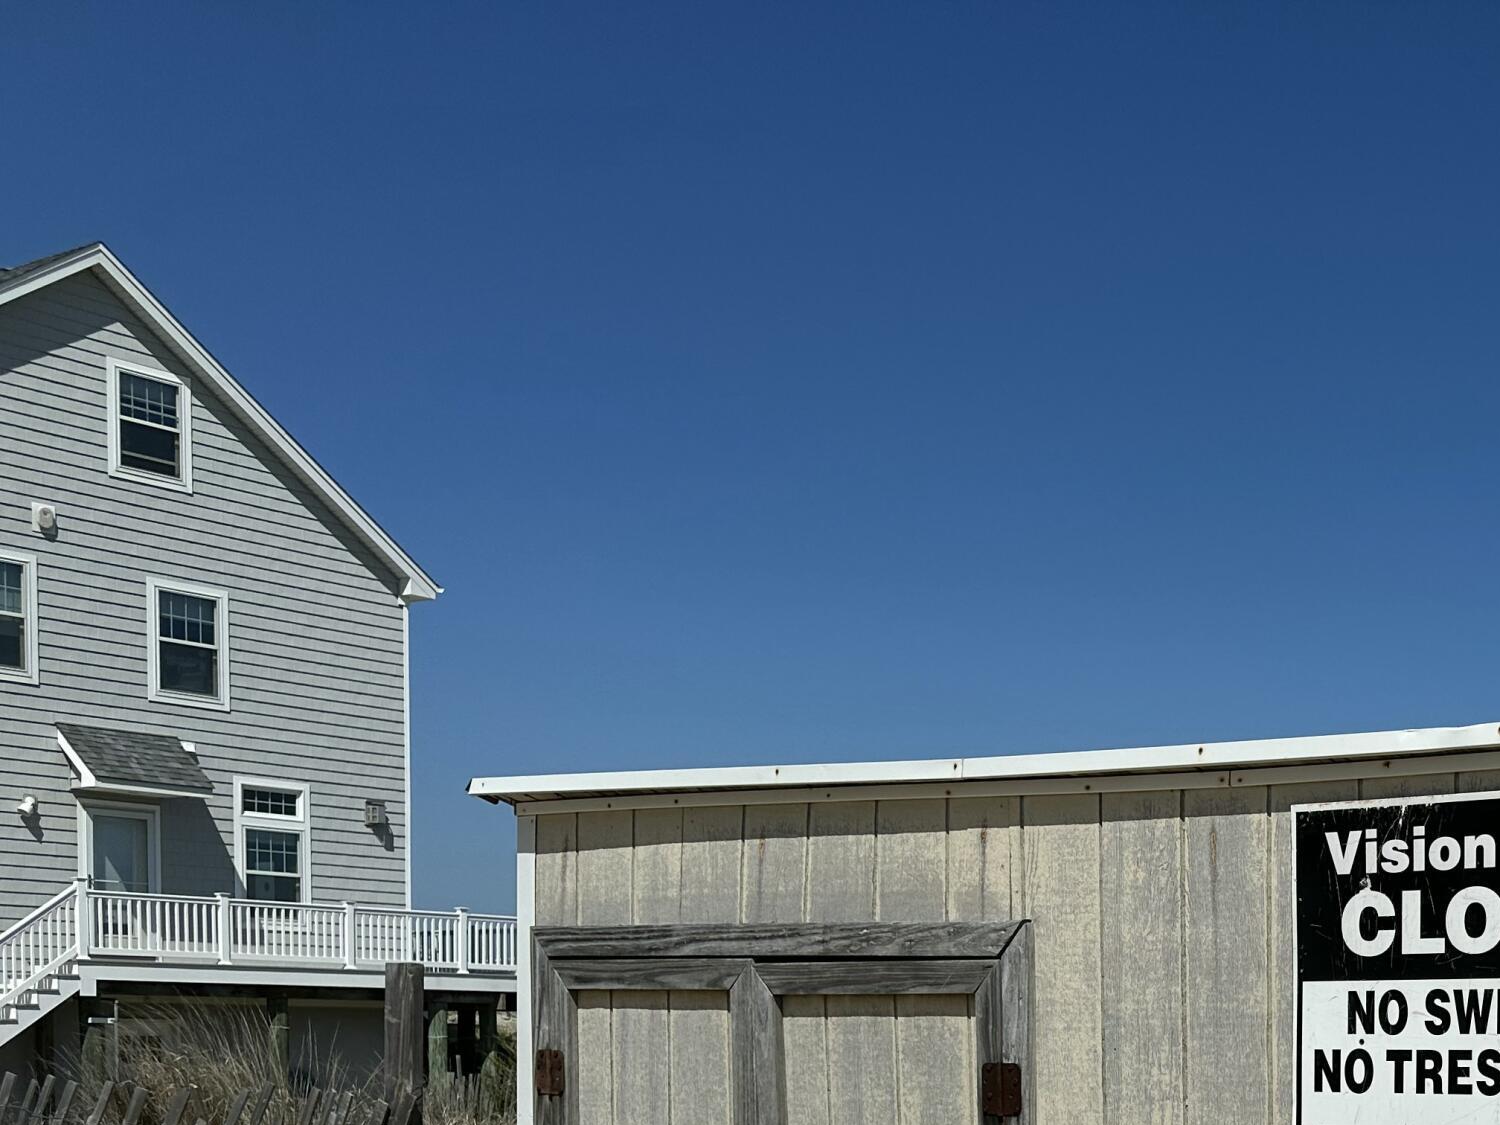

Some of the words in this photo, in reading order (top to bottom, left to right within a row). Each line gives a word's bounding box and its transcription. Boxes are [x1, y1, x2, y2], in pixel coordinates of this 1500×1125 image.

[1324, 825, 1496, 875] Vision
[1347, 989, 1408, 1036] NO
[1314, 1048, 1374, 1094] NO
